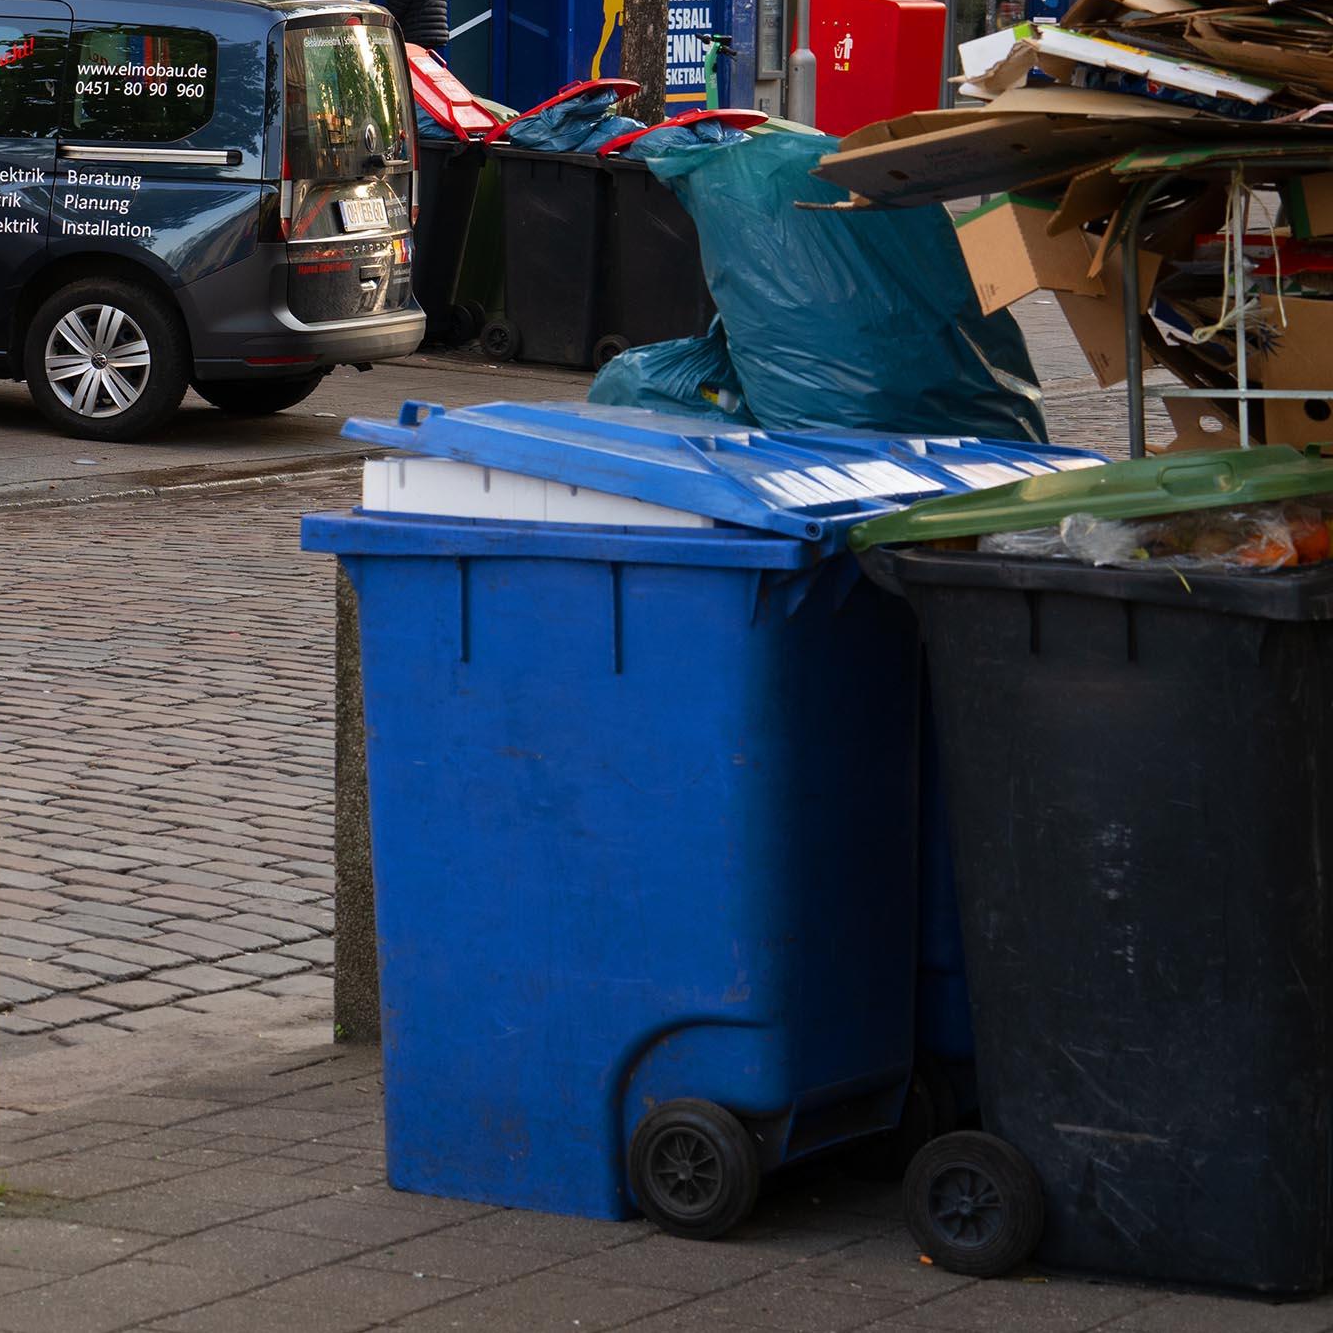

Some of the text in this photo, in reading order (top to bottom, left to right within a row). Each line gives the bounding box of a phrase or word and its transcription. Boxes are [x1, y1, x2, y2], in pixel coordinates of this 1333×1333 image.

[77, 62, 208, 78] www.elmobau.de
[75, 81, 110, 95] 0451
[123, 82, 142, 96] 80
[149, 82, 168, 97] 90
[176, 83, 205, 98] 960
[67, 170, 142, 191] Beratung
[64, 194, 130, 215] Planung
[62, 219, 152, 239] Installation
